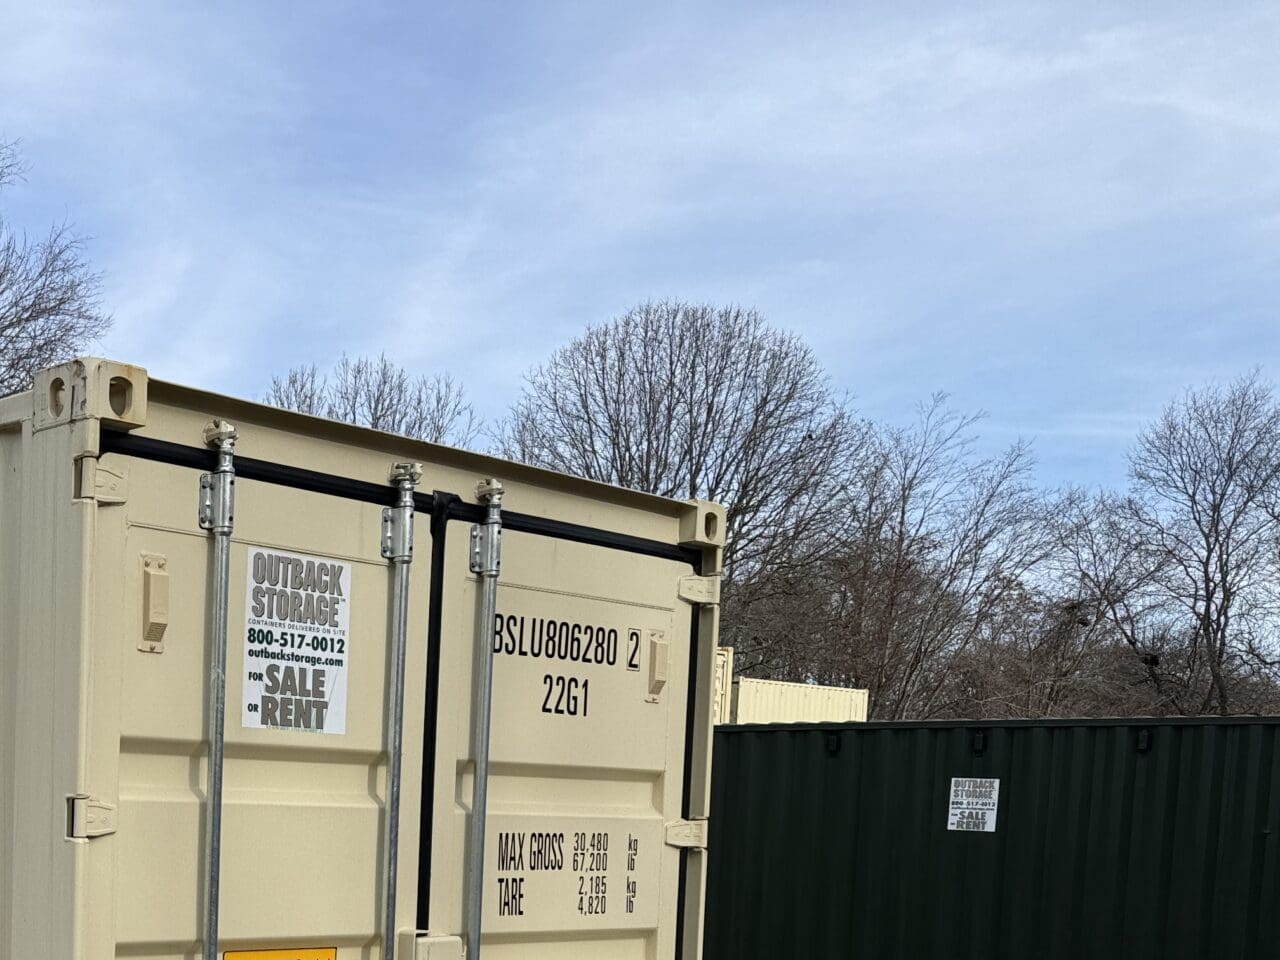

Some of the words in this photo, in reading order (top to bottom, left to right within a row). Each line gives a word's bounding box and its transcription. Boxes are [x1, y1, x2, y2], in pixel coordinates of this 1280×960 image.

[253, 552, 343, 596] OUTBACK
[252, 585, 339, 628] STORAGE
[248, 618, 285, 629] CONTAINERS
[288, 623, 320, 633] DELIVERED
[248, 627, 345, 654] 800-517-0012
[628, 632, 639, 668] 2
[248, 647, 343, 667] outbackstorage.com
[248, 672, 263, 681] FOR
[265, 664, 325, 698] SALE
[542, 674, 589, 716] 22G1
[247, 703, 258, 712] OR
[261, 695, 328, 729] RENT
[953, 780, 995, 789] OUTBACK
[953, 788, 993, 799] STORAGE
[956, 820, 987, 830] RENT
[959, 811, 987, 820] SALE
[498, 833, 525, 871] MAX
[529, 833, 564, 871] GROSS
[573, 832, 608, 853] 30,480
[628, 833, 638, 856] kg
[573, 853, 607, 872] 67,200
[627, 853, 635, 871] lb
[498, 878, 524, 916] TARE
[578, 876, 607, 896] 2,185
[626, 876, 637, 898] kg
[578, 895, 606, 916] 4,820
[626, 895, 634, 913] lb
